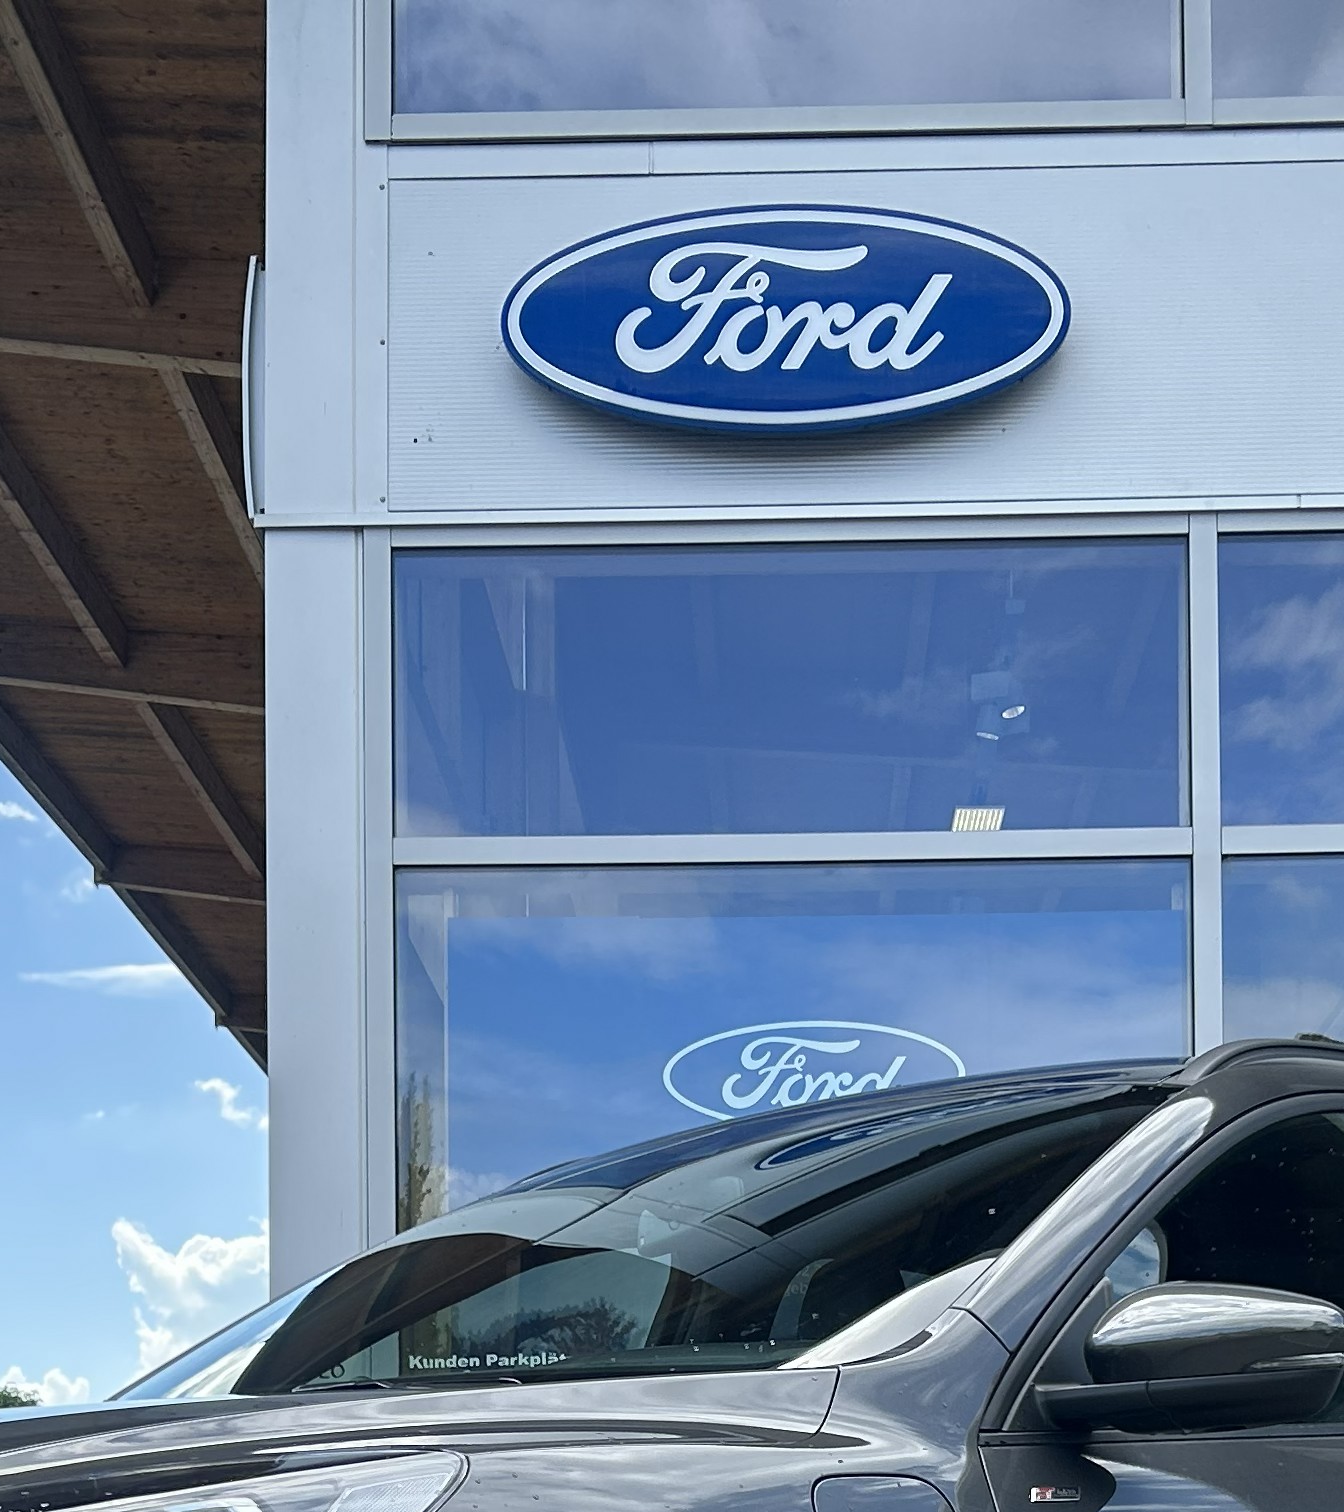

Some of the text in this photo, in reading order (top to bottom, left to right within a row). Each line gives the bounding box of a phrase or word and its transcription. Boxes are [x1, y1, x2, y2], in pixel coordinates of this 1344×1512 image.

[615, 241, 953, 373] Ford
[722, 1036, 906, 1109] Ford
[409, 1355, 481, 1369] Kunden
